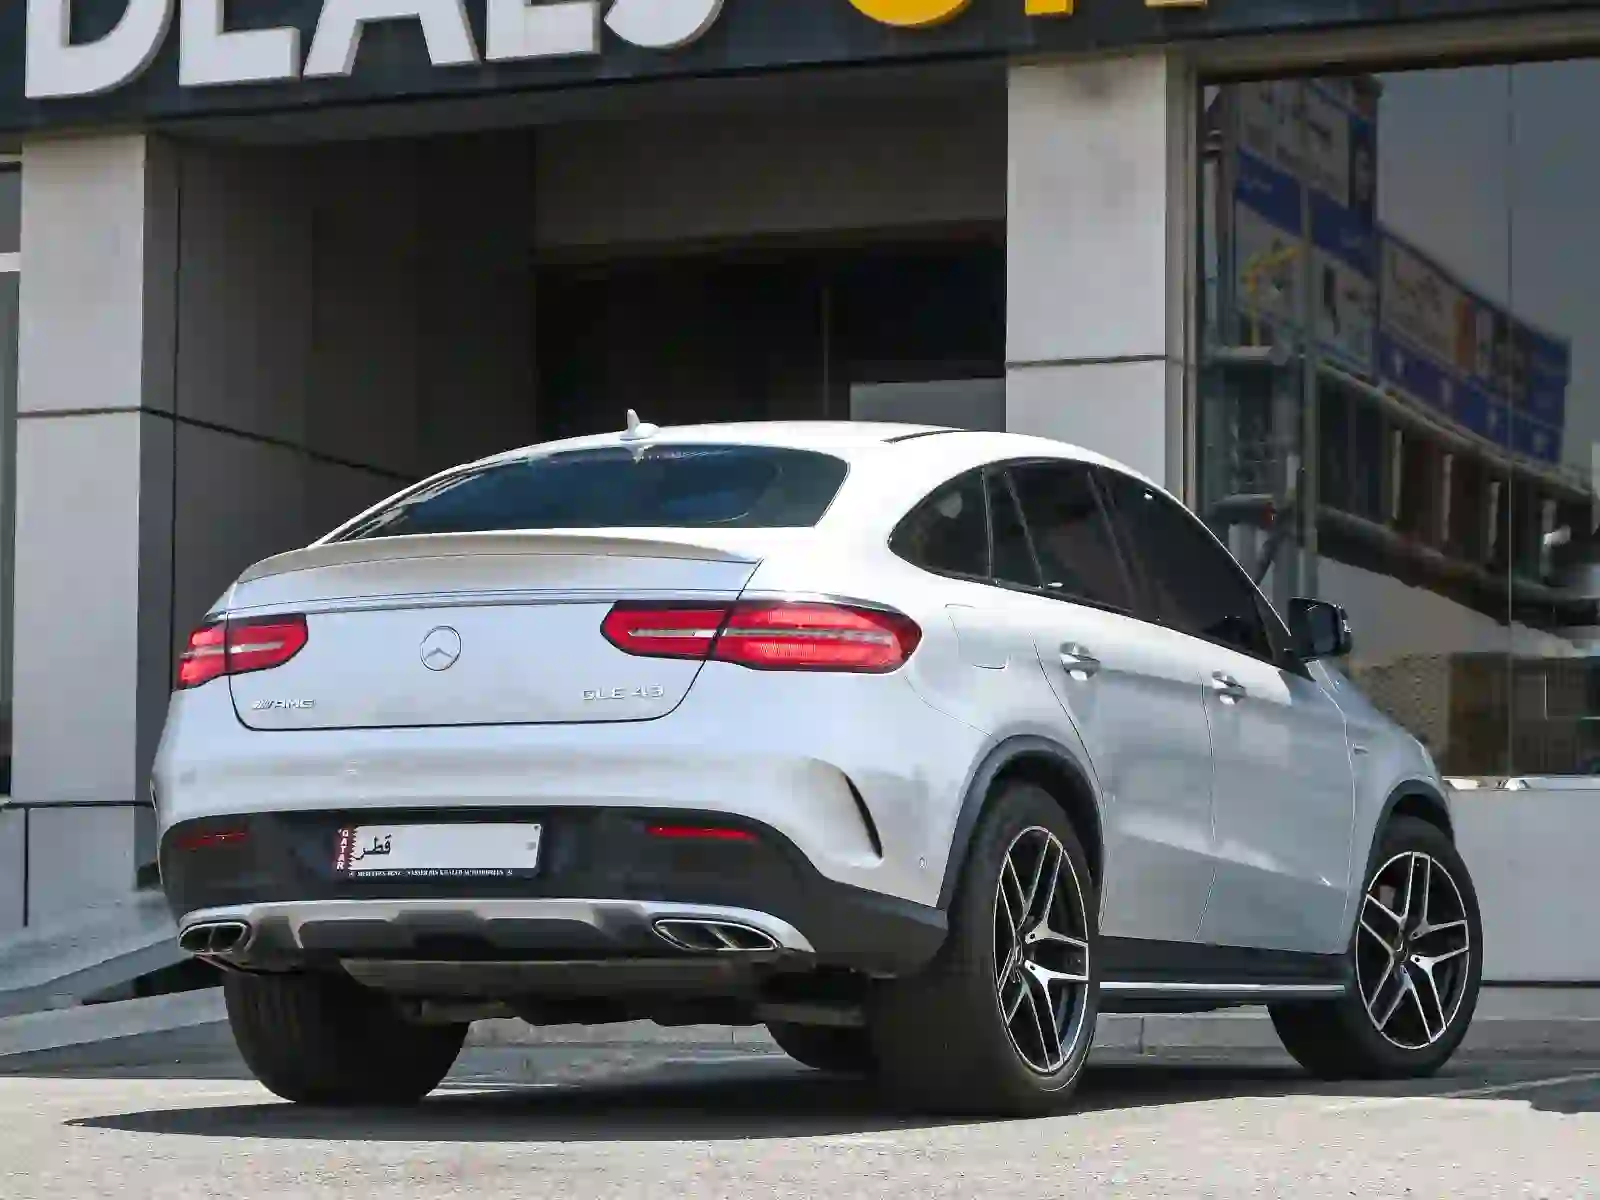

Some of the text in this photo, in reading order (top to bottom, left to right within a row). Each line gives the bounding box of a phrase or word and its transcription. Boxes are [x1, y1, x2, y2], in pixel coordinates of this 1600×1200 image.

[582, 683, 665, 701] GLE 43
[336, 829, 349, 870] QATAR
[352, 834, 392, 861] قطر
